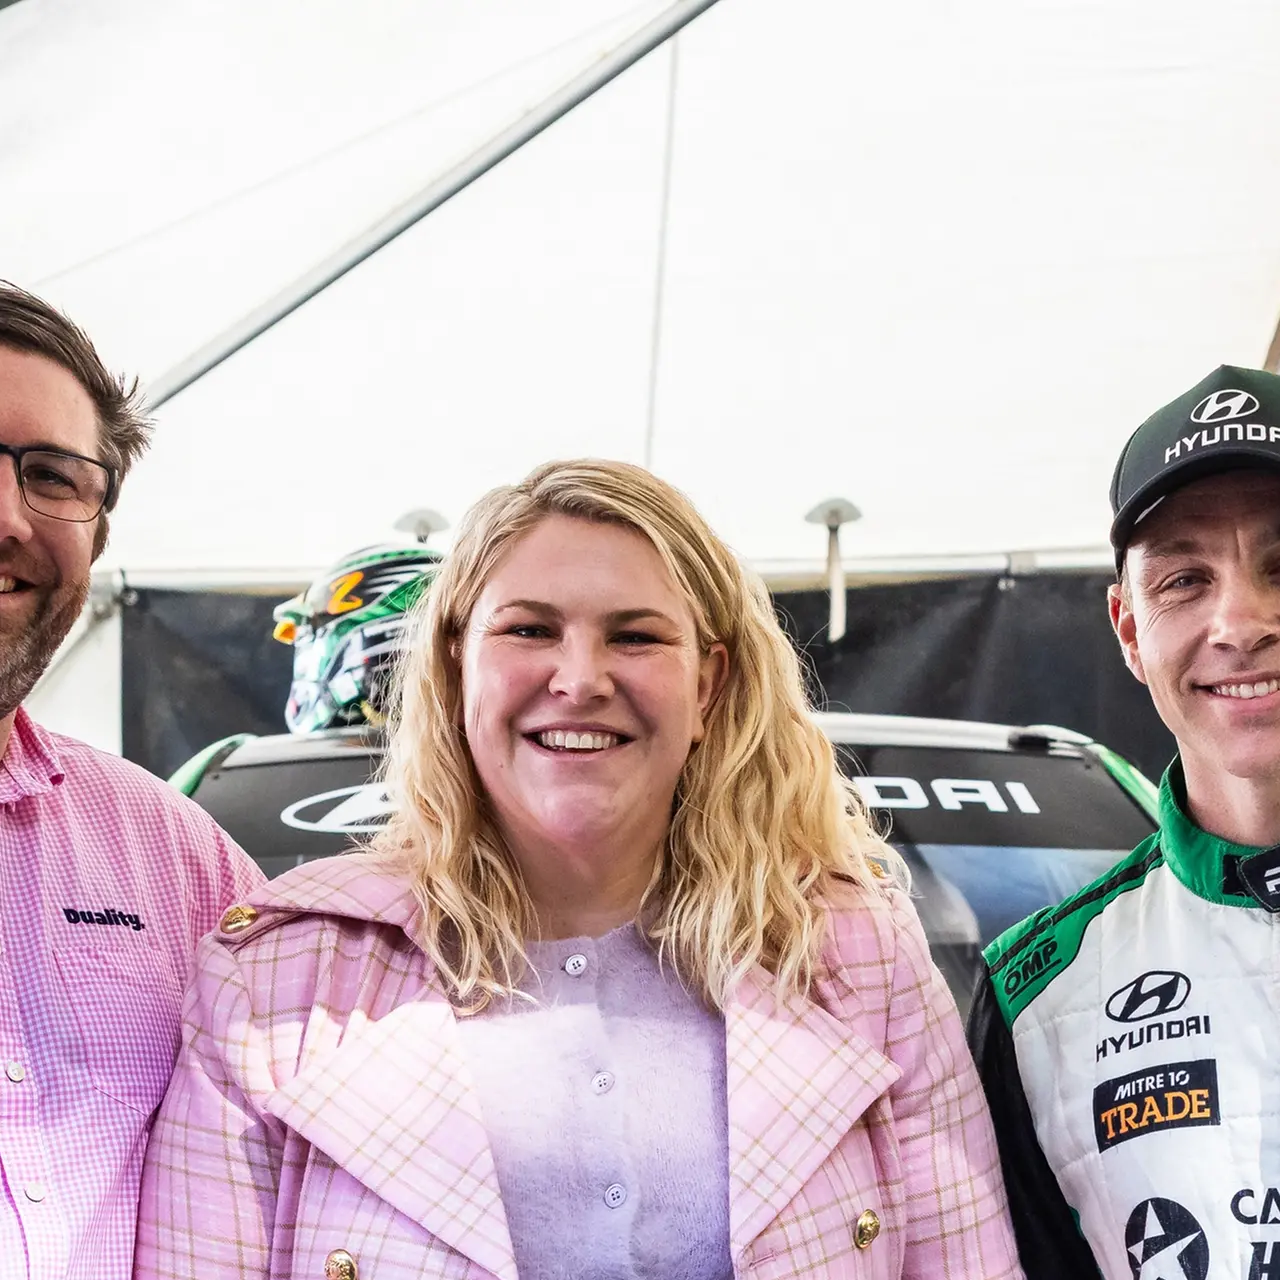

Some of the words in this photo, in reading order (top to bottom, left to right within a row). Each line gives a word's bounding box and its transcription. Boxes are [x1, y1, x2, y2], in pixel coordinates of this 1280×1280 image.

[1004, 940, 1058, 996] OMP
[1095, 1015, 1211, 1062] HYUNDAI
[1114, 1073, 1164, 1101] MITRE
[1168, 1070, 1190, 1086] 10
[1100, 1088, 1211, 1140] TRADE
